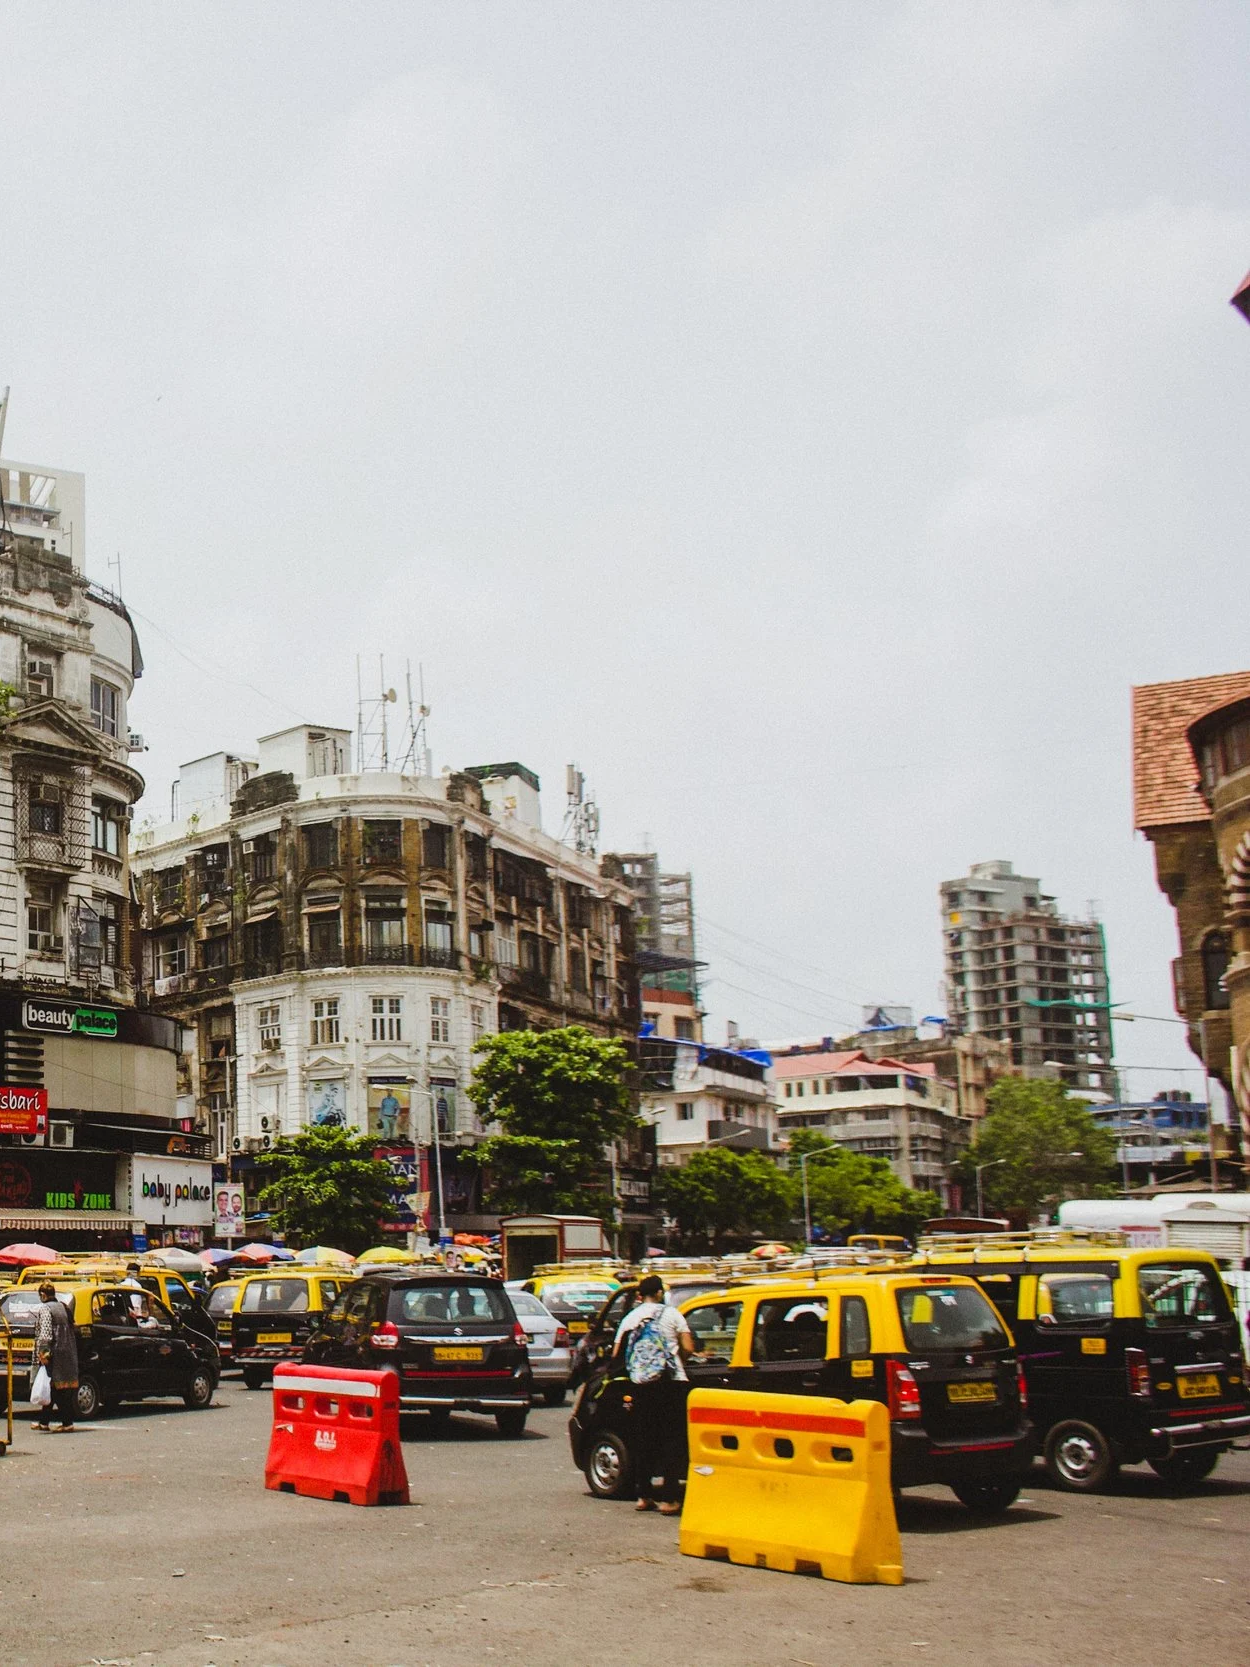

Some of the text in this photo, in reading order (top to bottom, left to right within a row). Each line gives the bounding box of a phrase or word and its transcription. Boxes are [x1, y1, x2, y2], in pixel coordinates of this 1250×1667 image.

[28, 1004, 117, 1031] beauty palace
[45, 1191, 111, 1210] KIDS ZONE
[141, 1172, 211, 1208] baby palace
